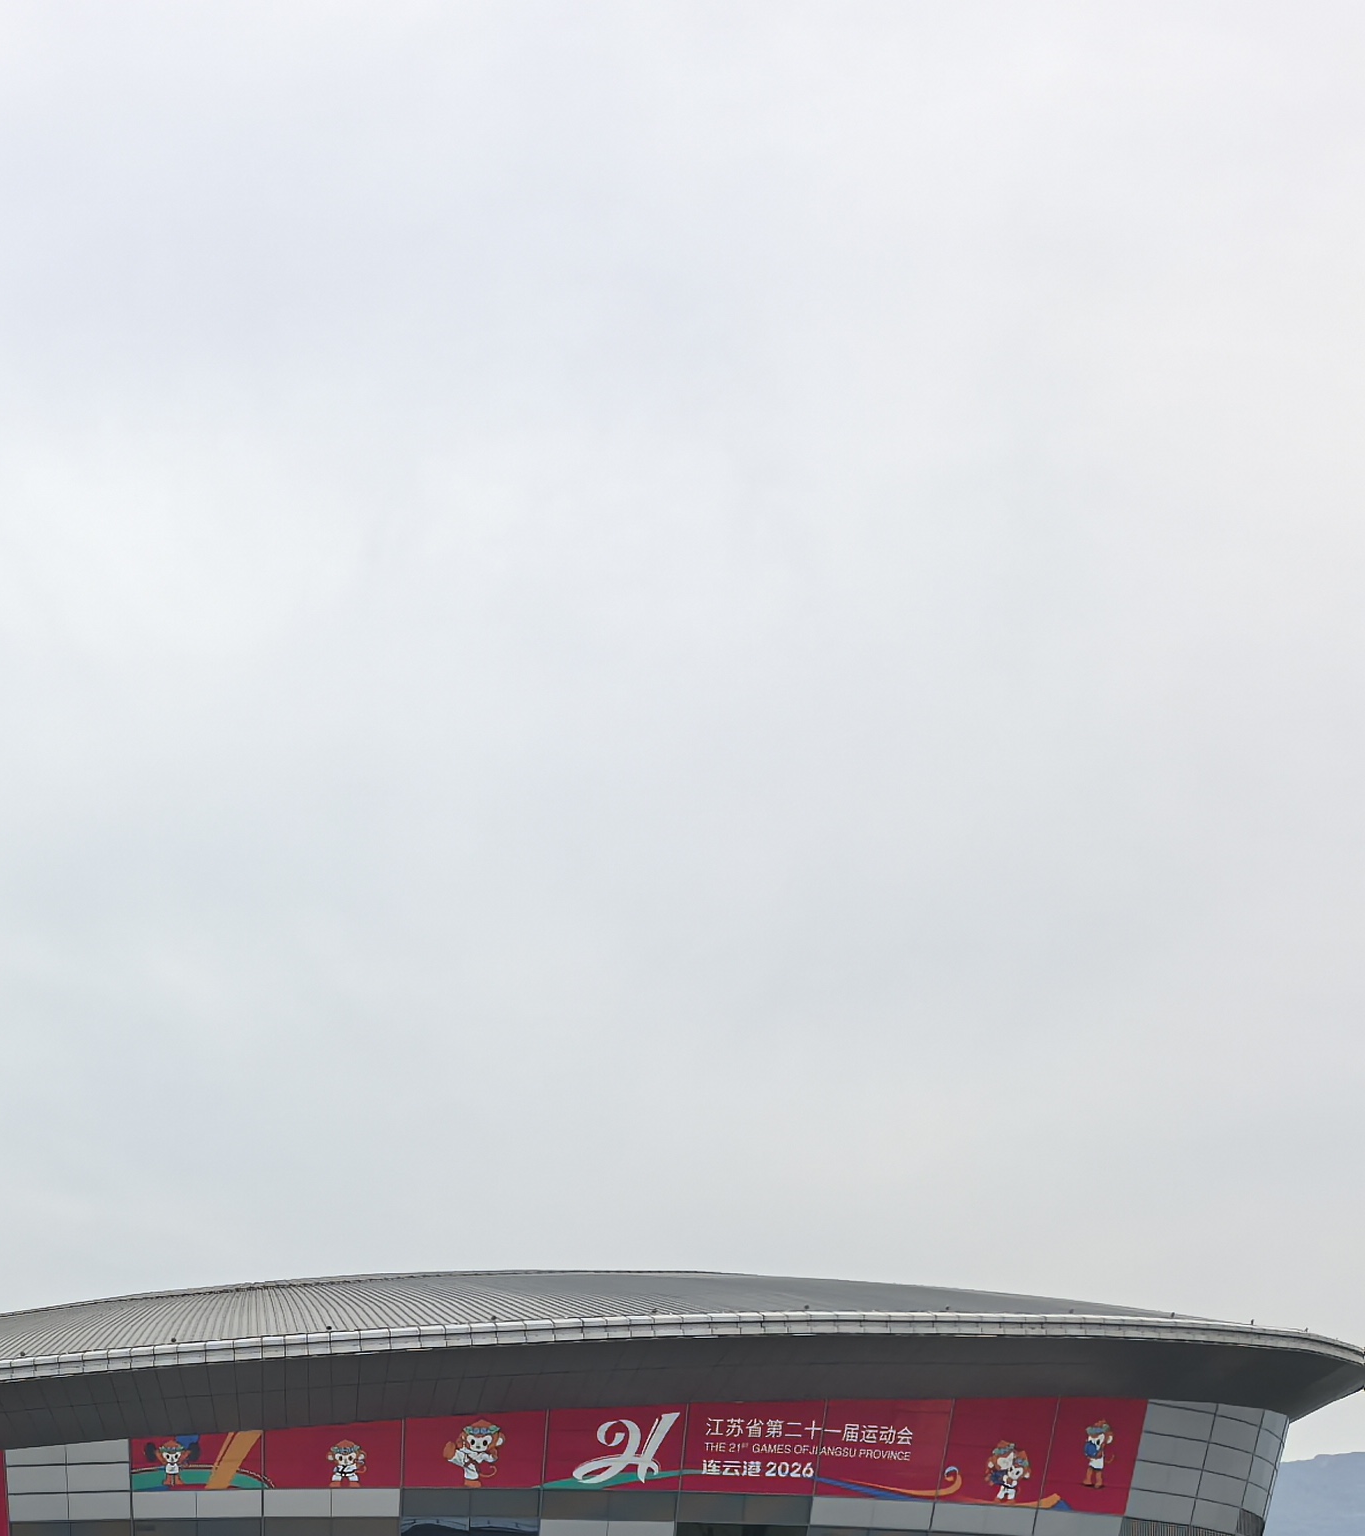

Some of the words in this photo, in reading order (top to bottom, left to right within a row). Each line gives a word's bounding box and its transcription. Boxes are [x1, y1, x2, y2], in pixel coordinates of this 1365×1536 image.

[705, 1417, 914, 1446] 江苏省第二十一届运动会
[704, 1442, 726, 1452] THE
[752, 1444, 791, 1454] GAMES
[793, 1445, 808, 1455] OF
[808, 1445, 857, 1458] JIANGSU
[858, 1448, 911, 1461] PROVINCE
[702, 1460, 762, 1477] 连云港
[765, 1461, 814, 1478] 2026
